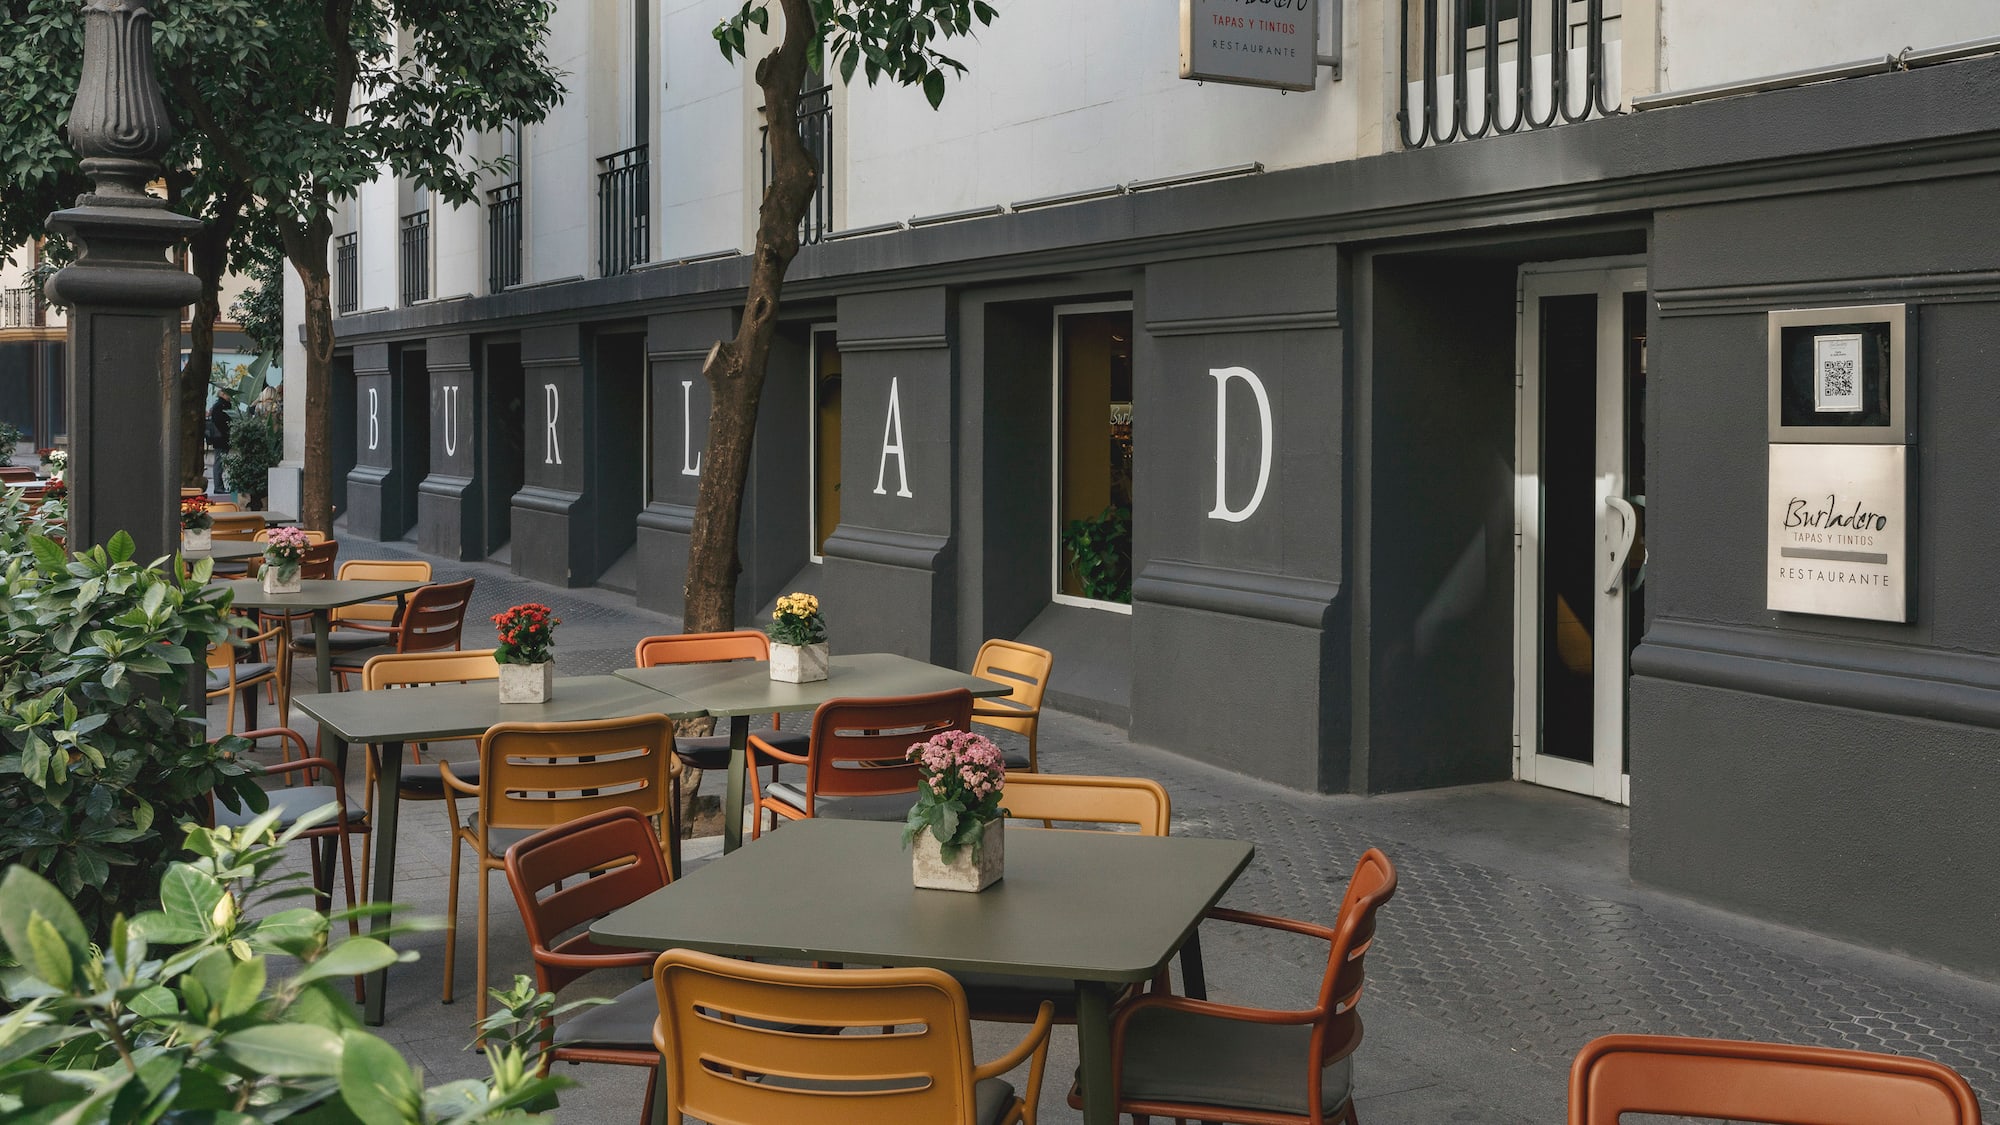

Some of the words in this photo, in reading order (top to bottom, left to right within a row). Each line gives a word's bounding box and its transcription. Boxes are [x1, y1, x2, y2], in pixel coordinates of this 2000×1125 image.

[1213, 14, 1244, 29] TAPAS
[1248, 18, 1254, 30] Y
[1259, 19, 1295, 35] TINTOS
[1212, 39, 1295, 58] RESTAURANTE
[1783, 494, 1887, 531] Burladero
[1794, 532, 1823, 543] TAPAS
[1827, 534, 1833, 544] Y
[1837, 535, 1873, 546] TINTOS
[1780, 567, 1889, 587] RESTAURANTE
